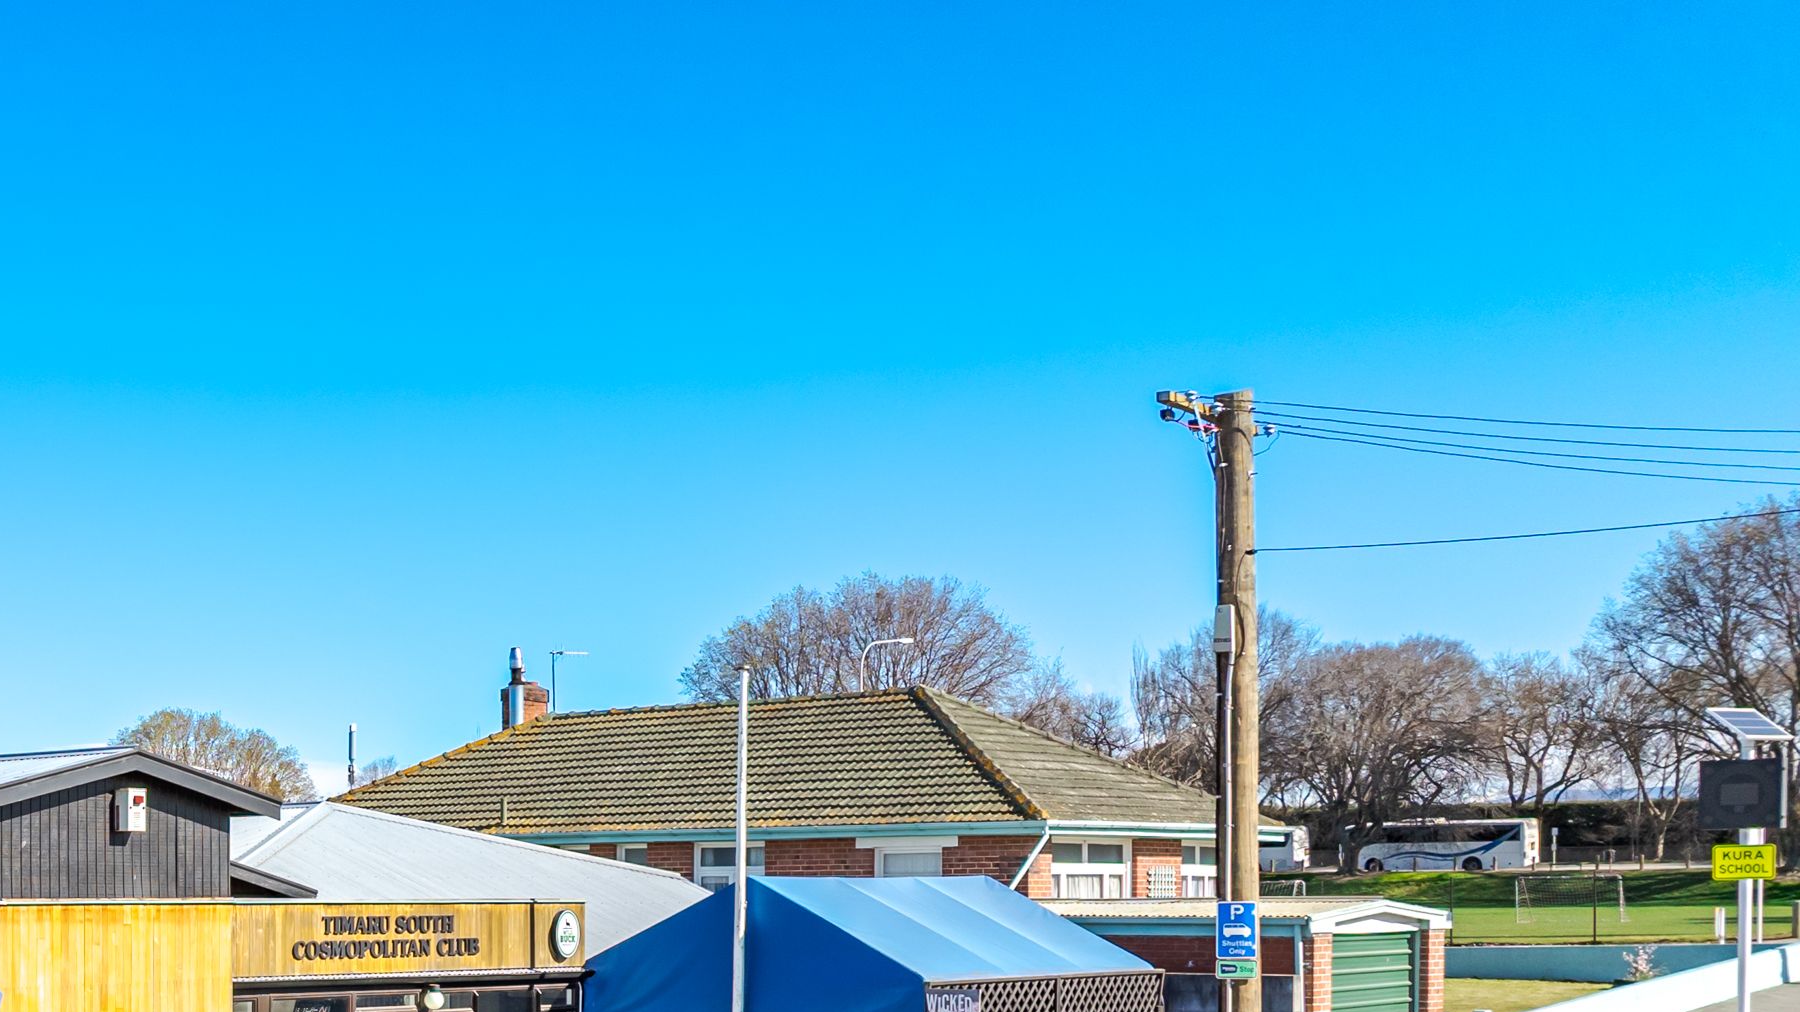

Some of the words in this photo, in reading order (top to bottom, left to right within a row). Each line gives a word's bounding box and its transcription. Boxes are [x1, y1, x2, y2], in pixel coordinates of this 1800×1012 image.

[1723, 851, 1764, 860] KURA
[1719, 864, 1768, 874] SCHOOL
[1230, 904, 1244, 920] P
[322, 915, 390, 935] TIMARU
[394, 915, 455, 934] SOUTH
[292, 938, 431, 961] COSMOPOLITAN
[436, 937, 480, 957] CLUB
